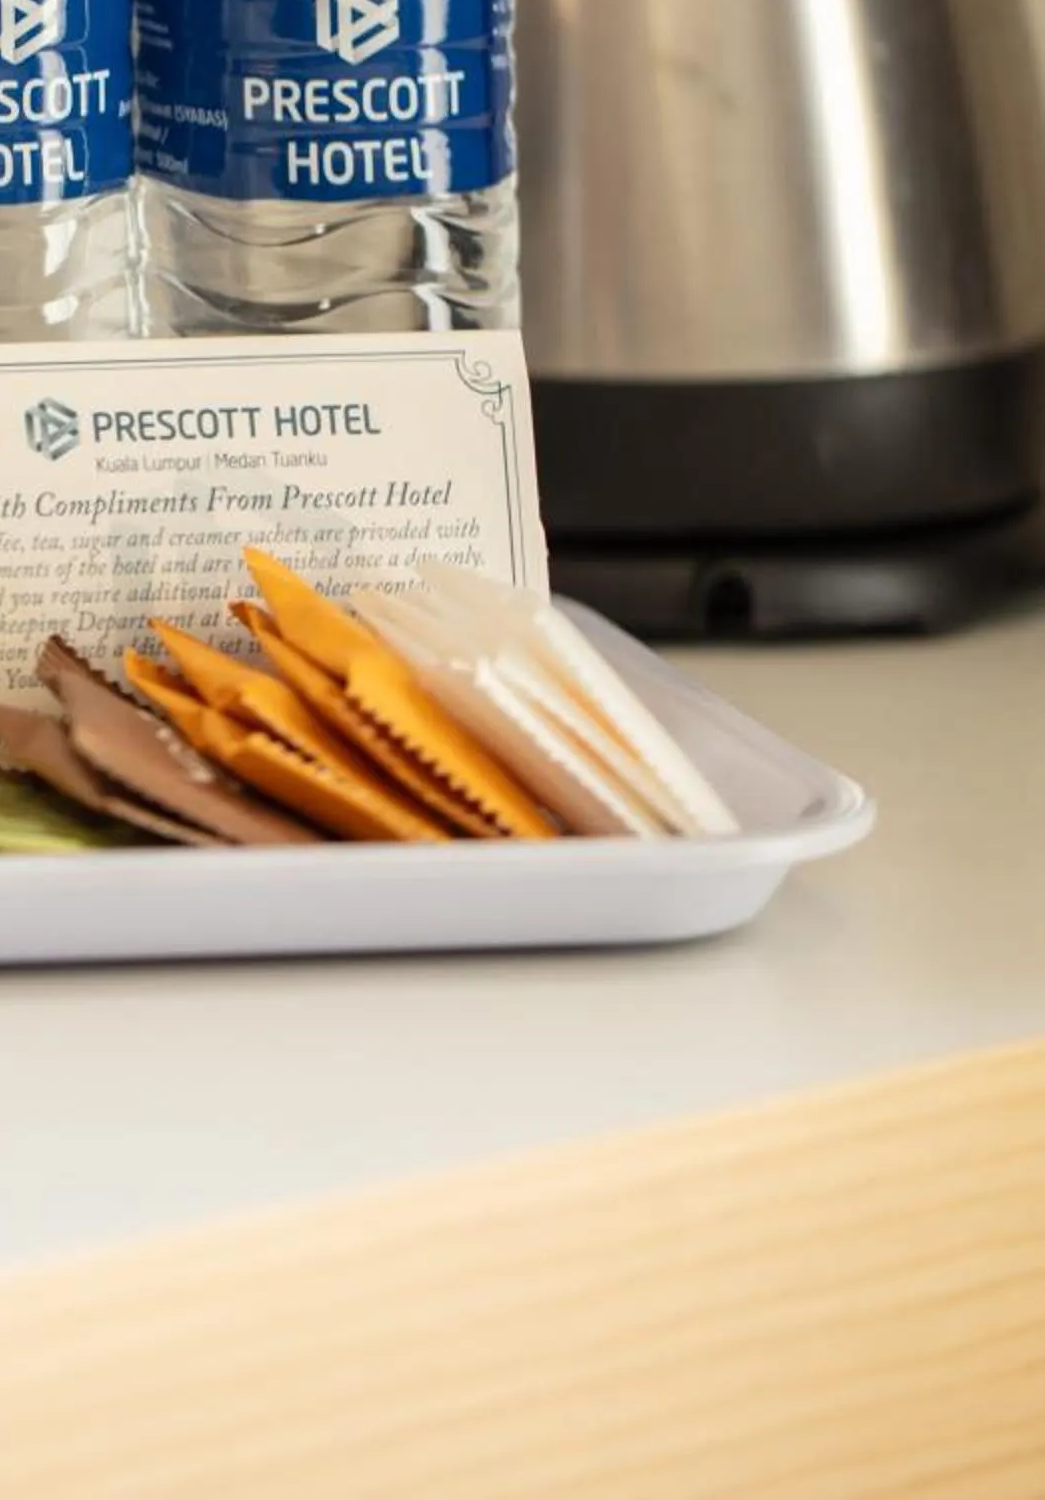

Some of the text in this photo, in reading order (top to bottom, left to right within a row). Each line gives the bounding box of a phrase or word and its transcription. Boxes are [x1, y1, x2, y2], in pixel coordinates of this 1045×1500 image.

[243, 71, 465, 124] PRESCOTT
[288, 138, 434, 185] HOTEL
[92, 403, 382, 443] PRESCOTT HOTEL
[95, 450, 328, 474] Kuala Lumpur Medan Tuanku
[35, 488, 199, 524] Compliments
[207, 485, 272, 512] From
[282, 483, 377, 510] Prescott
[385, 479, 453, 507] Hotel
[31, 531, 65, 551] tea,
[72, 533, 122, 555] sugar
[126, 526, 166, 547] and
[168, 530, 243, 547] creamer
[247, 522, 307, 544] sachets
[314, 526, 344, 542] are
[436, 517, 481, 539] with
[56, 556, 78, 584] of
[79, 557, 107, 577] the
[111, 553, 159, 576] hotel
[161, 551, 199, 574] and
[202, 557, 232, 574] are
[344, 553, 385, 570] once
[388, 553, 400, 568] a
[10, 589, 45, 616] you
[50, 588, 122, 613] require
[126, 579, 231, 602] additional
[77, 609, 195, 643] Departent
[200, 611, 221, 628] at
